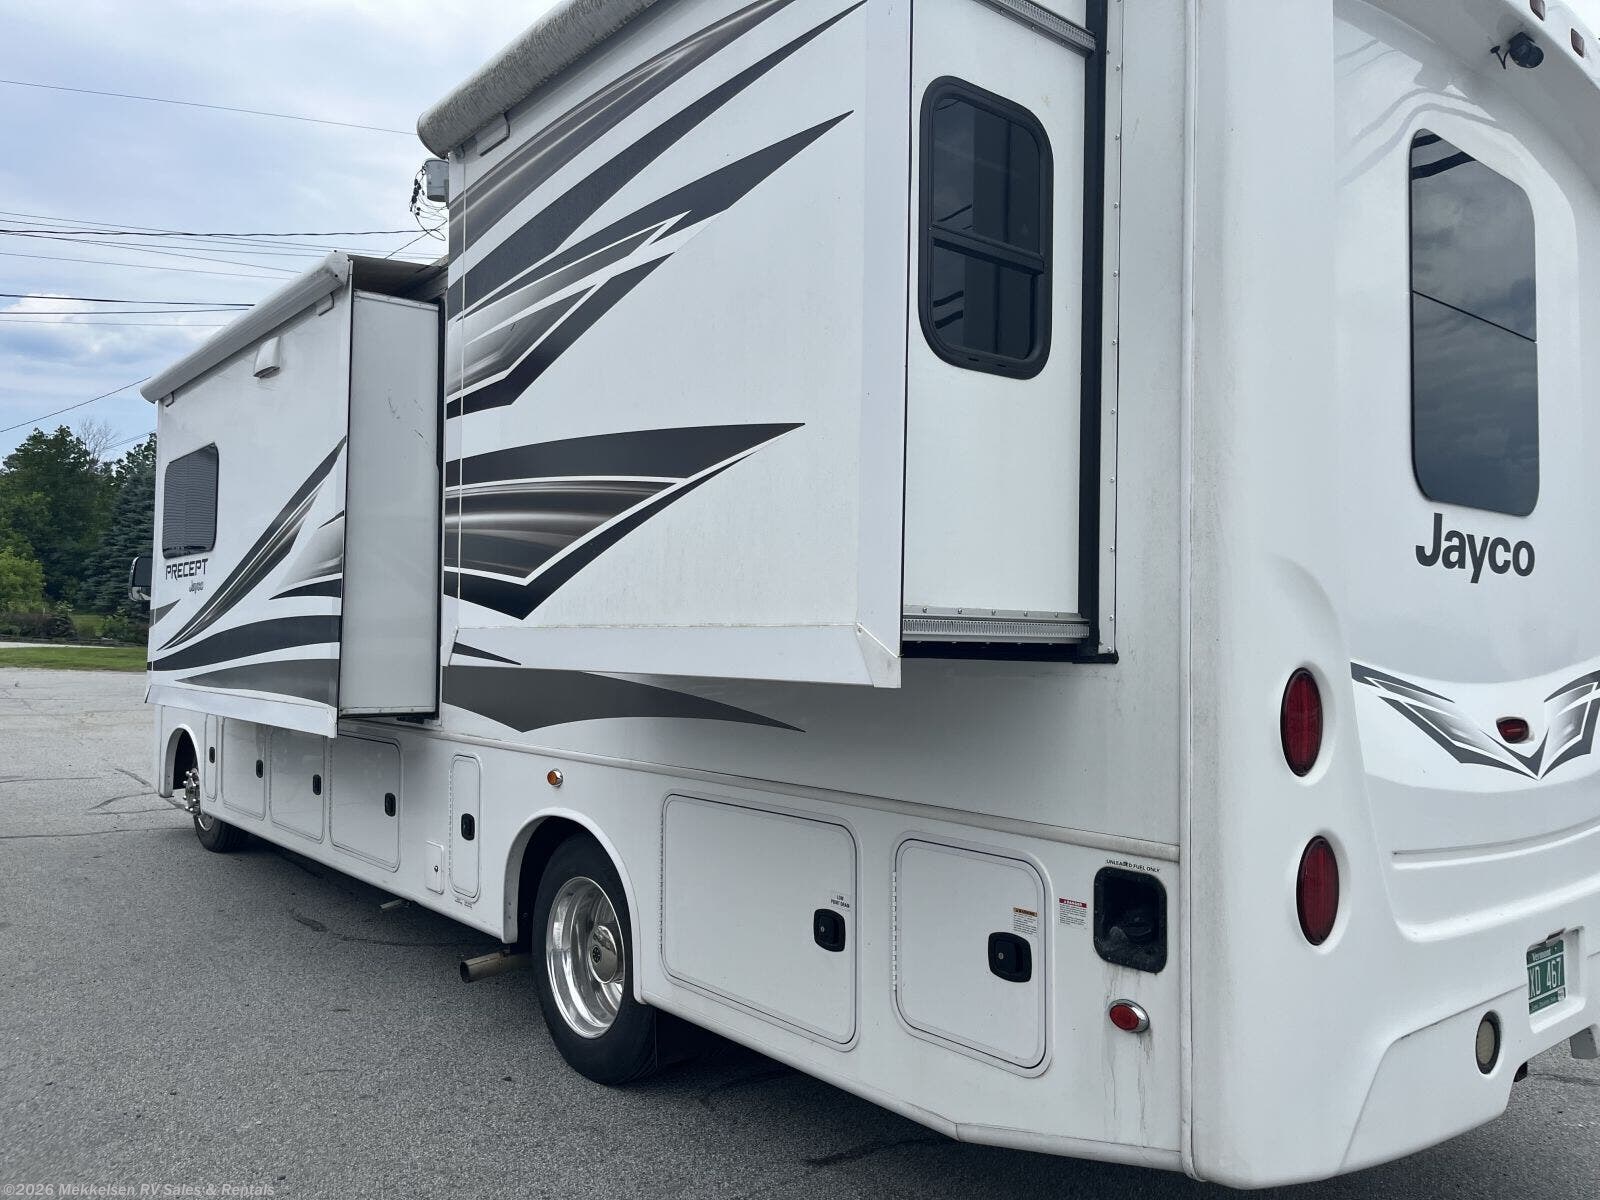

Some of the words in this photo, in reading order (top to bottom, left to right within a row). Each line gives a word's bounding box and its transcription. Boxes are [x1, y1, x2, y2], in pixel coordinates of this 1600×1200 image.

[1415, 512, 1536, 584] Jayco
[165, 558, 208, 580] PRECEPT
[1546, 957, 1562, 990] 467
